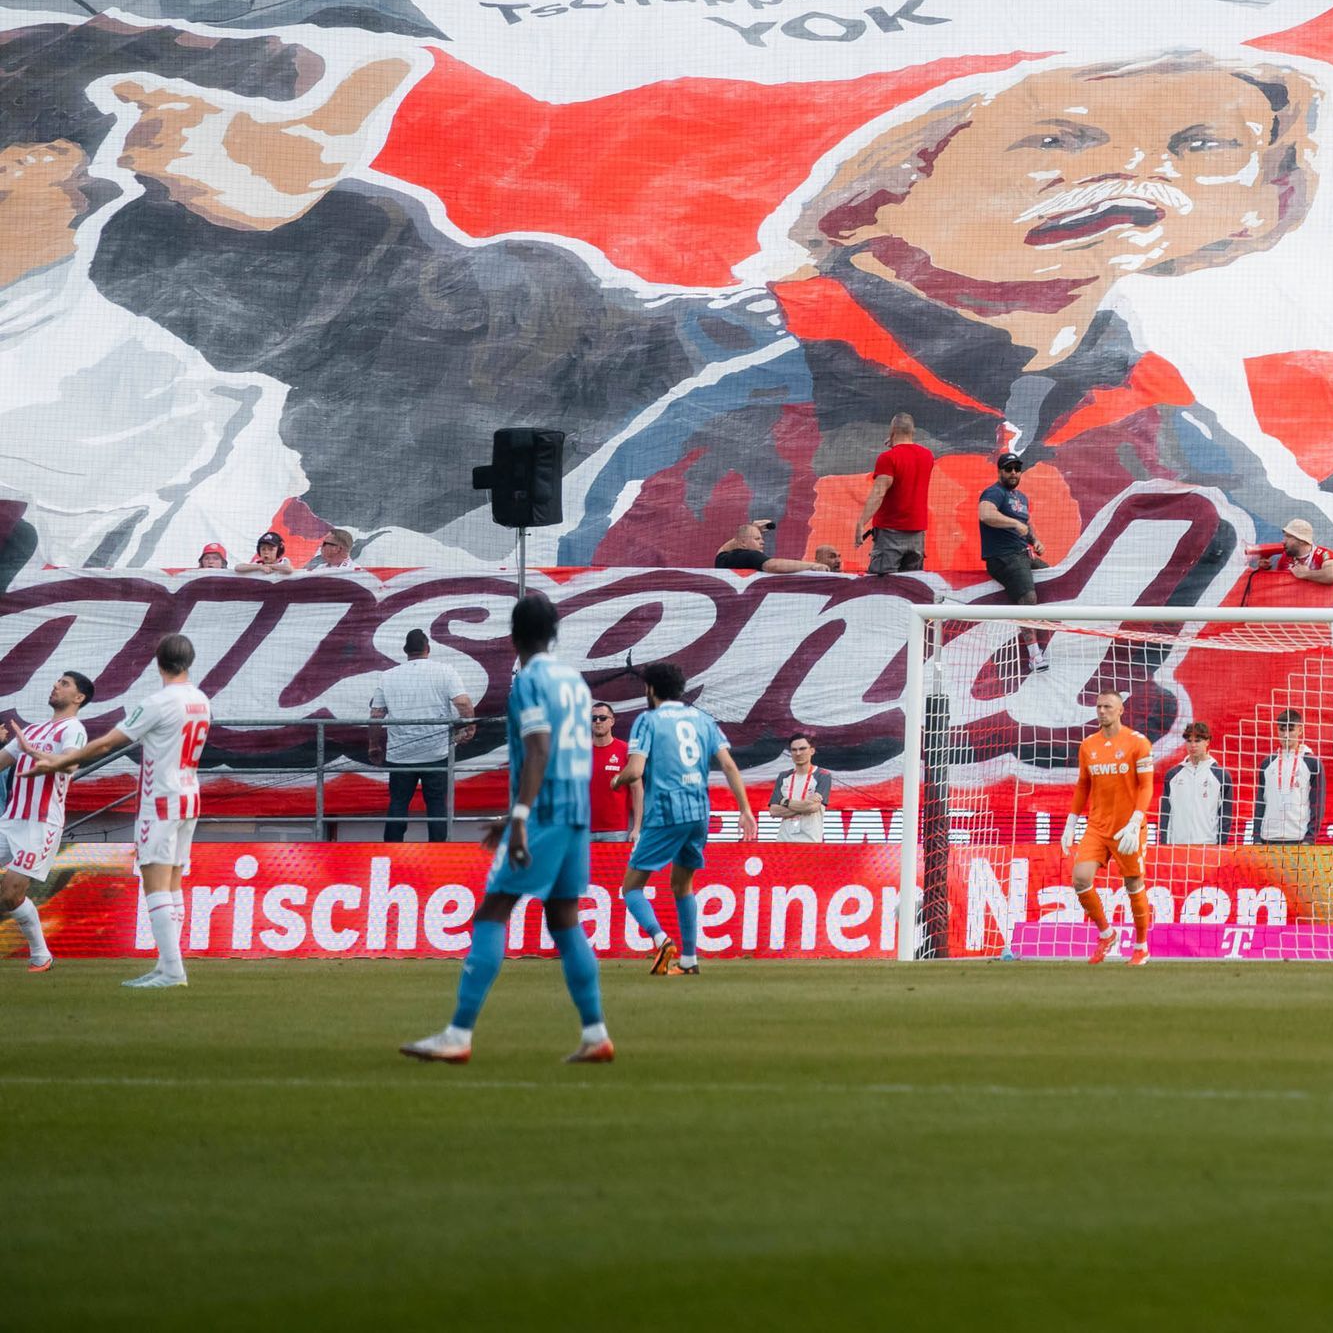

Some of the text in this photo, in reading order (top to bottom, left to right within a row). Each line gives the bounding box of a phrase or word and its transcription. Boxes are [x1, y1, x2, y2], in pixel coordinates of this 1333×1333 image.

[0, 506, 1225, 746] ausend
[557, 681, 593, 751] 23
[675, 720, 701, 767] 8
[13, 849, 37, 871] 39
